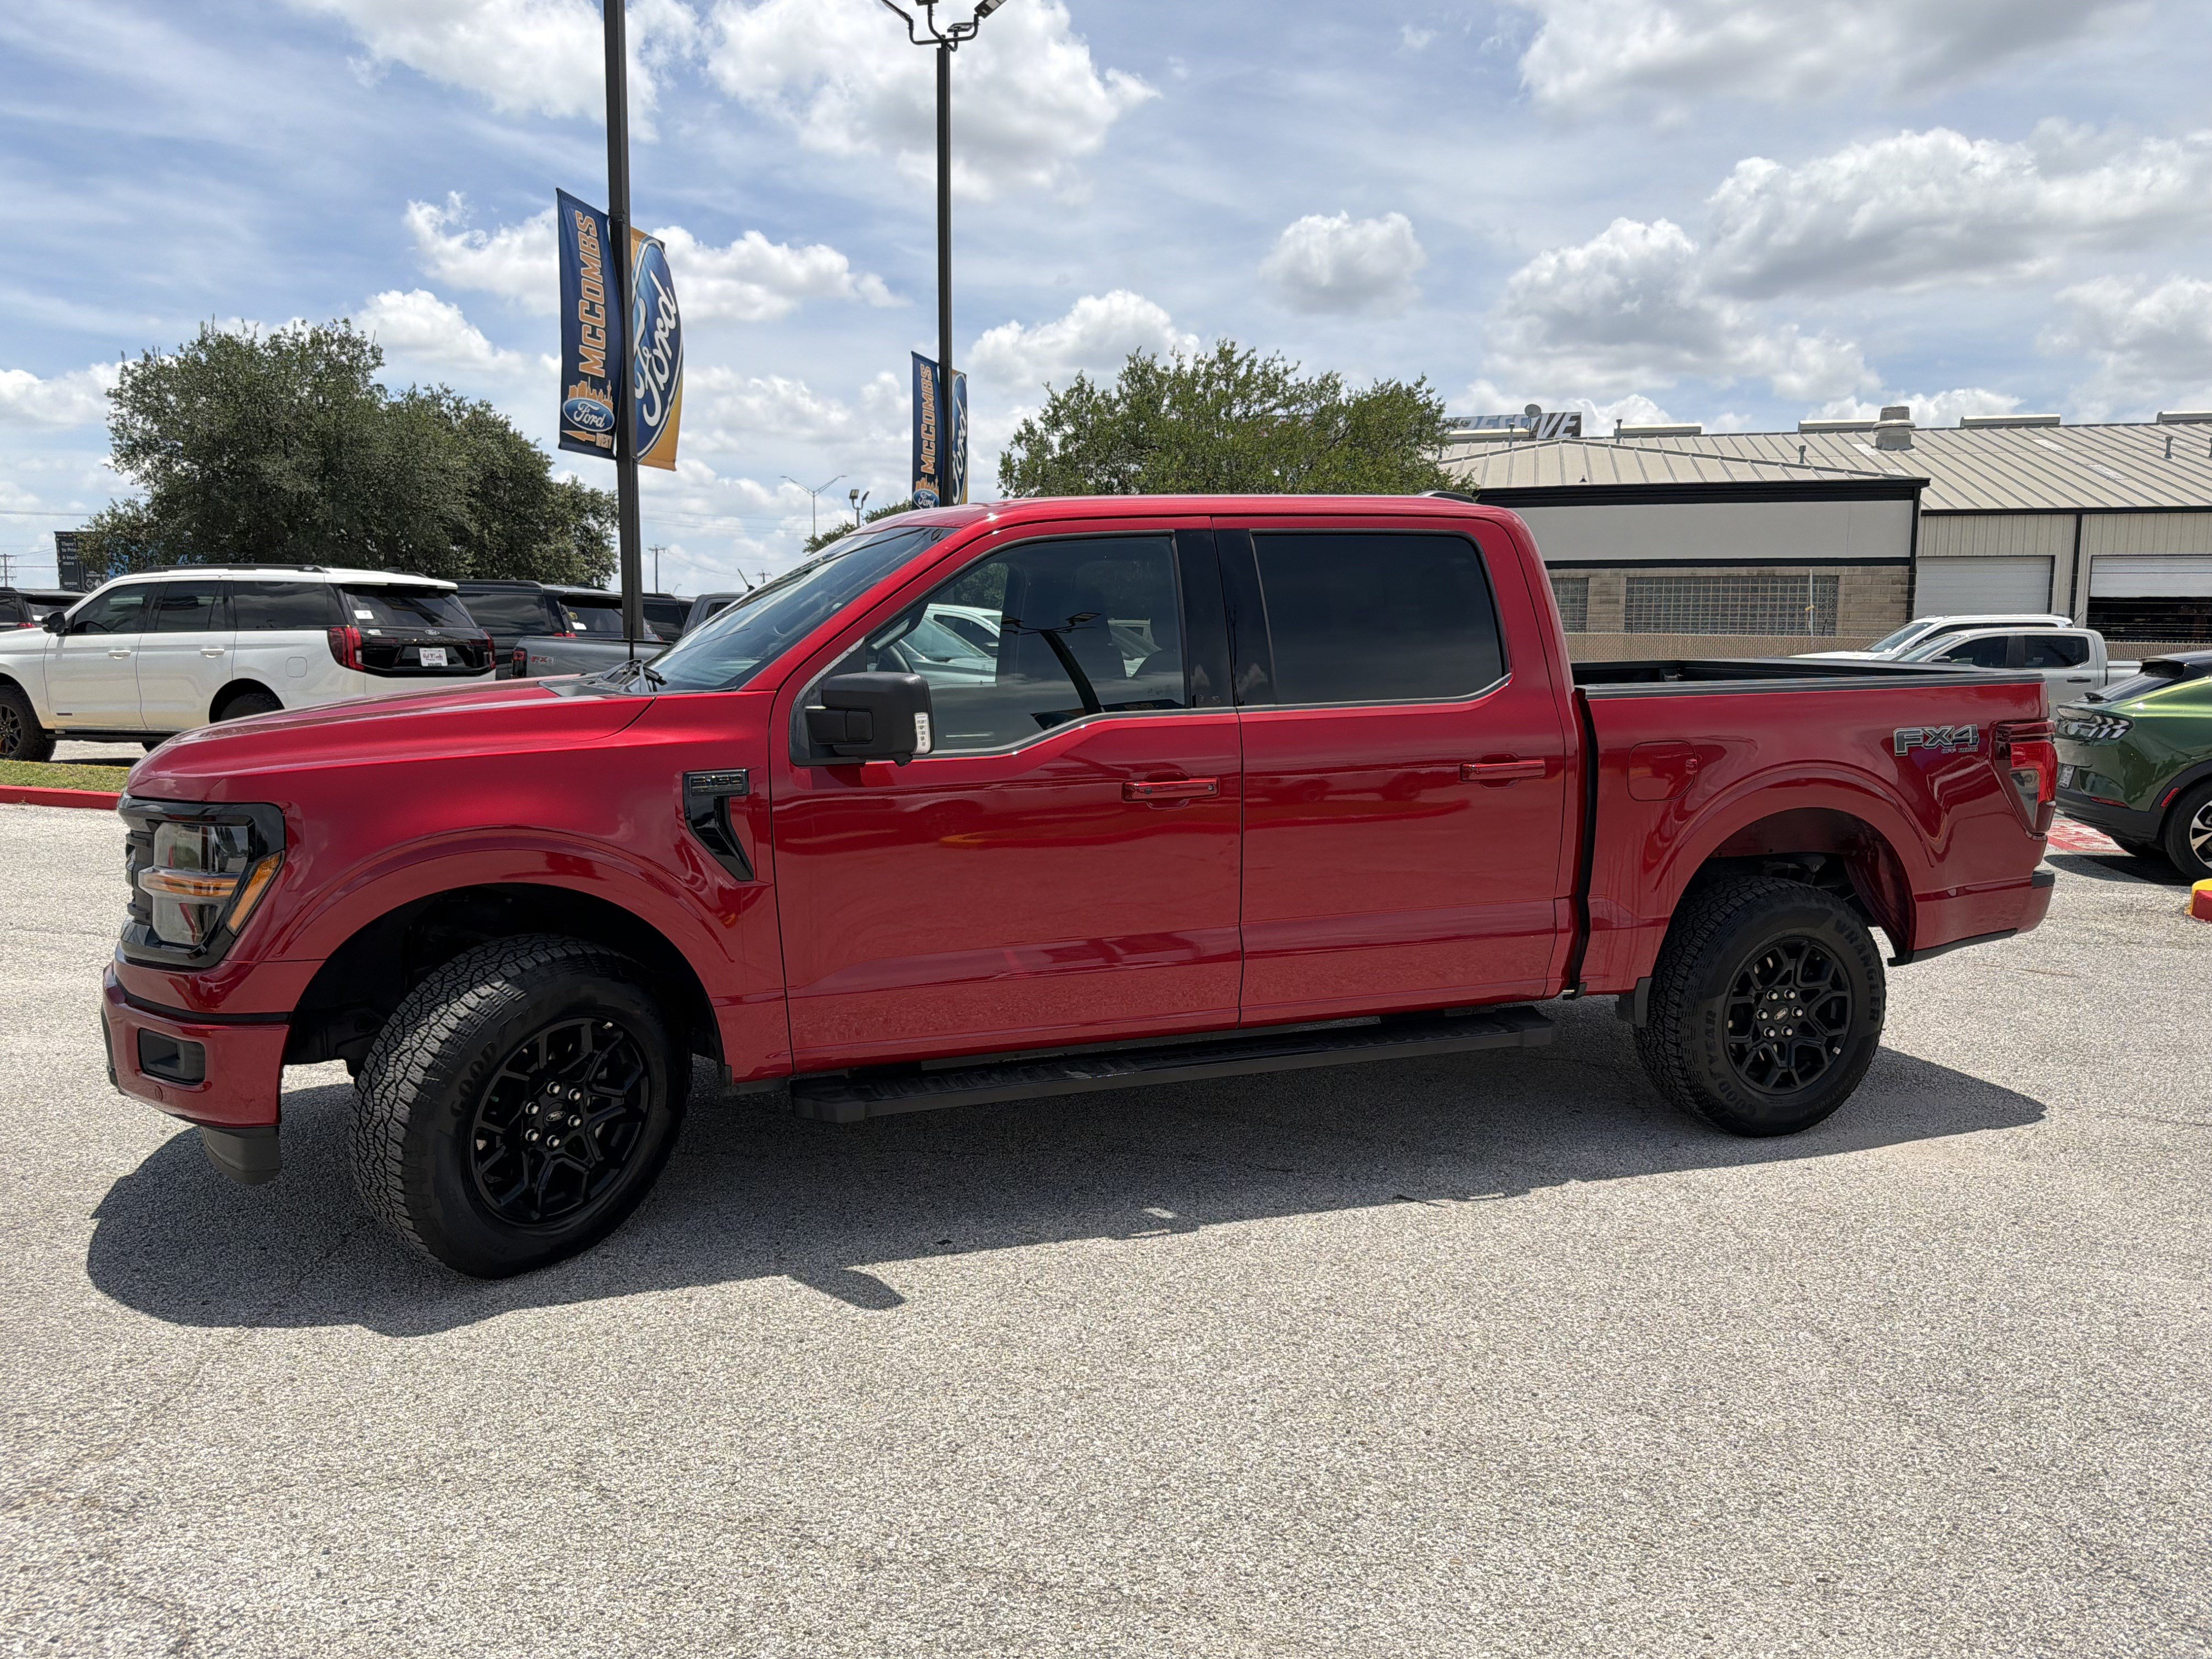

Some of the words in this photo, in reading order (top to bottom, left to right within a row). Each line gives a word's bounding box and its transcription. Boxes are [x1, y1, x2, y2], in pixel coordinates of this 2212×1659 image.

[573, 402, 607, 428] Ford
[595, 432, 613, 449] WEST
[918, 491, 935, 508] Ford
[1893, 724, 1979, 757] FX4
[1834, 919, 1881, 1022] WRANGLER
[1704, 1010, 1757, 1115] GOODYEAR
